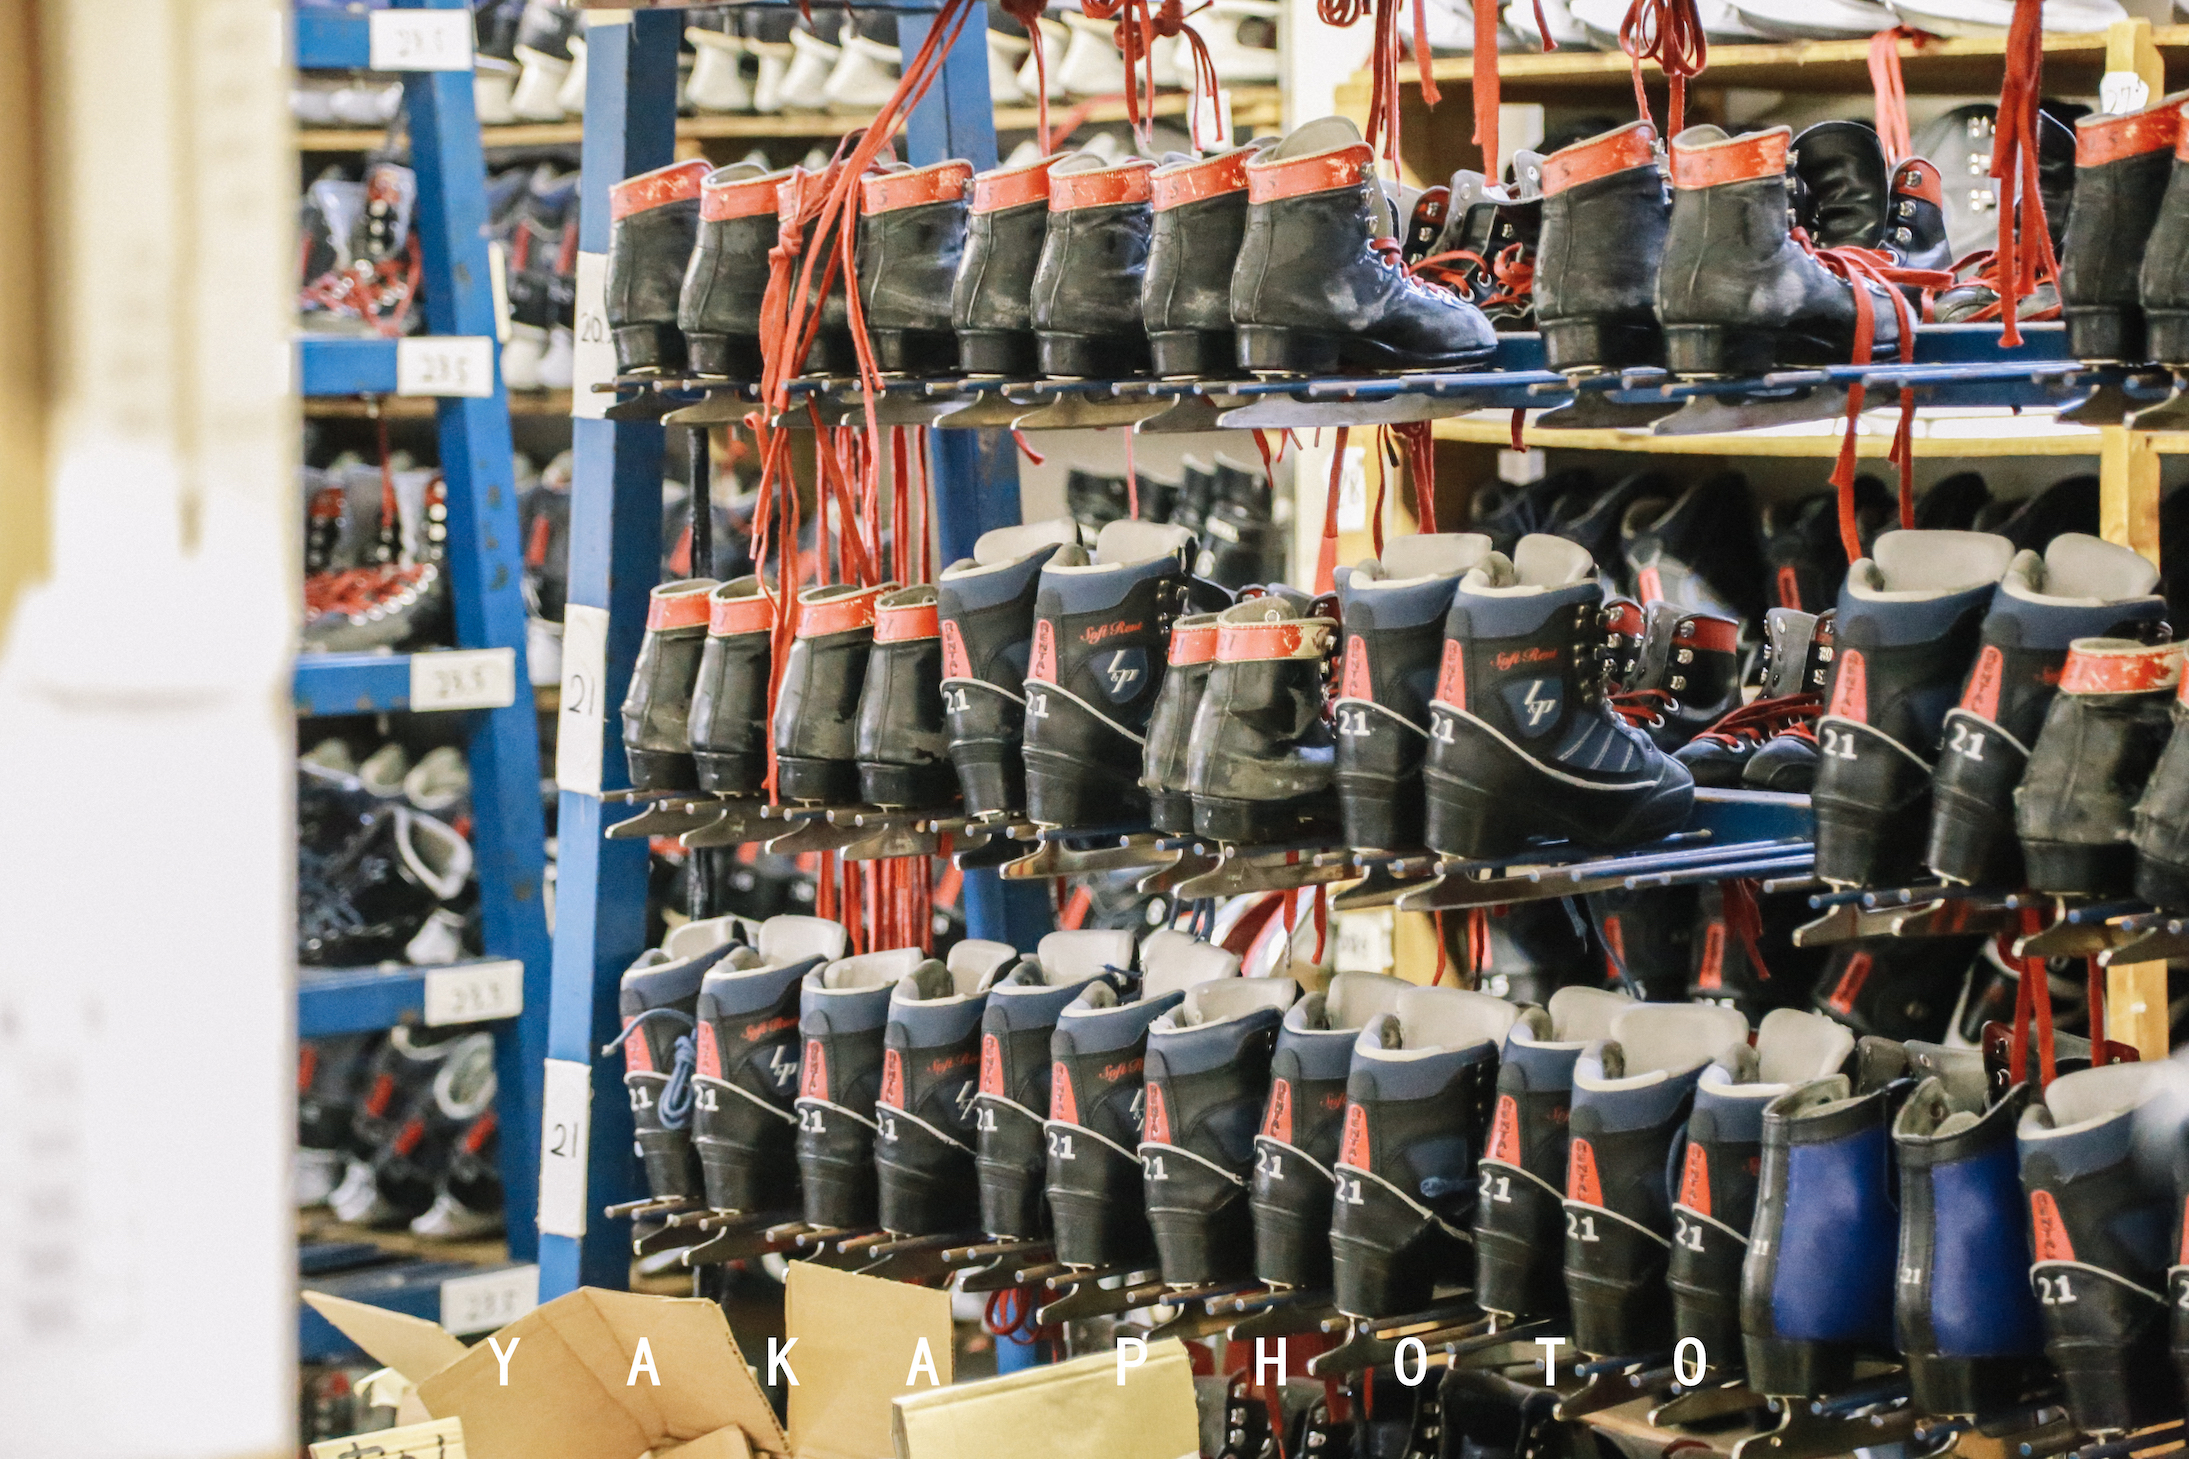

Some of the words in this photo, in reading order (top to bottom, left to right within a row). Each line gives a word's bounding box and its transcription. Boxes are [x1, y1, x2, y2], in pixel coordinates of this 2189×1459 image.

[568, 673, 596, 716] 21
[943, 688, 971, 715] 21
[1026, 690, 1049, 718] 21
[1339, 710, 1371, 736] 21
[1430, 712, 1455, 744] 21
[1822, 728, 1858, 760] 21
[1949, 723, 1986, 761] 21
[629, 1086, 653, 1112] 21
[694, 1085, 719, 1112] 21
[1270, 1081, 1286, 1138] RENTAL
[799, 1107, 826, 1133] 21
[976, 1107, 998, 1132] 21
[1495, 1098, 1512, 1159] RENTAL
[551, 1122, 579, 1158] 21
[1049, 1132, 1076, 1160] 21
[1141, 1155, 1168, 1181] 21
[1257, 1147, 1284, 1181] 21
[1335, 1174, 1364, 1206] 21
[1479, 1170, 1511, 1204] 21
[1566, 1211, 1600, 1242] 21
[1674, 1215, 1705, 1252] 21
[1901, 1267, 1921, 1284] 21
[2037, 1275, 2077, 1304] 21
